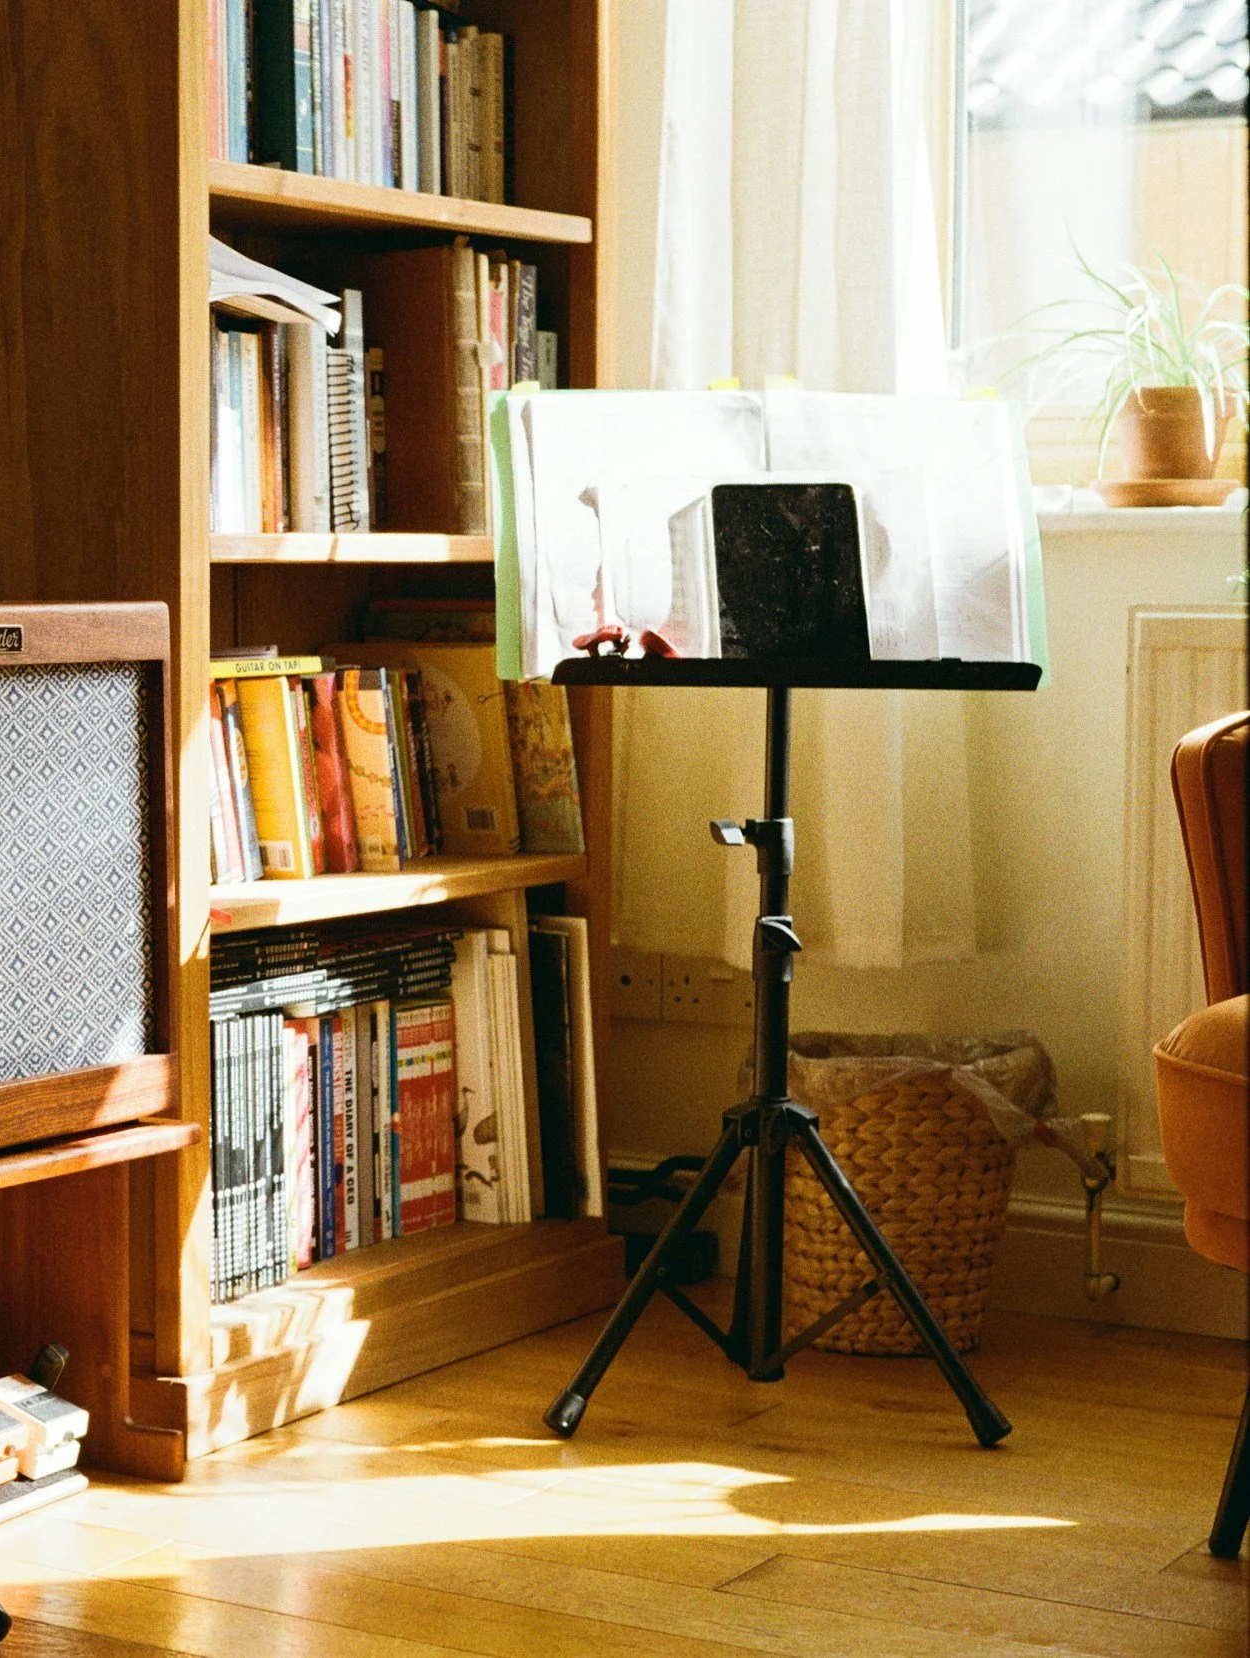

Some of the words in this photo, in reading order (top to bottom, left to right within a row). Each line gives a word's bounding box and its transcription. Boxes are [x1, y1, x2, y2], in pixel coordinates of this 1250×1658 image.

[235, 661, 265, 674] GUITAR
[268, 660, 281, 672] ON
[331, 1031, 344, 1117] BRAINSTORM
[344, 1068, 354, 1095] THE
[345, 1098, 354, 1139] DIARY
[346, 1143, 354, 1159] OF
[346, 1165, 355, 1174] A
[346, 1177, 356, 1206] CEO
